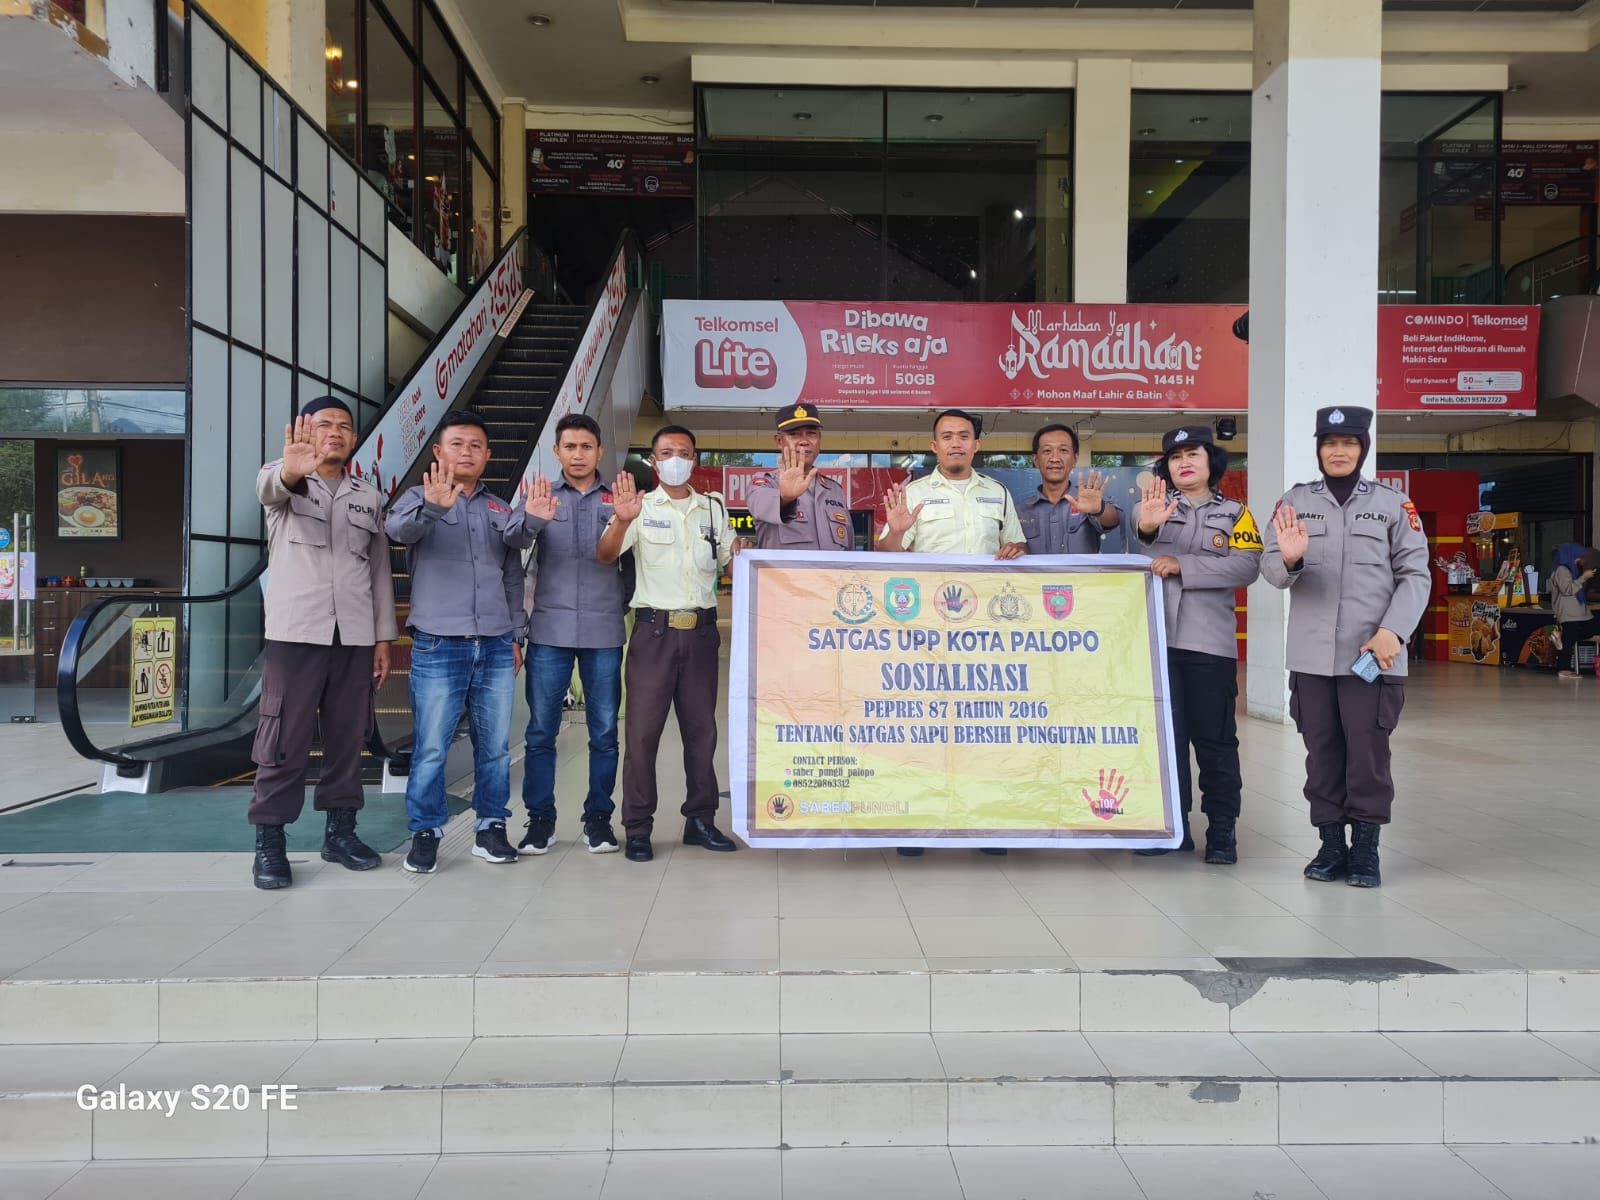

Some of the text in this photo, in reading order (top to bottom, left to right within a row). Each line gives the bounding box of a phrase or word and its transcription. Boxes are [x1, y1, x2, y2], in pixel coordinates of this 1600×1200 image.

[694, 316, 779, 333] Telkomsel
[844, 308, 929, 332] Dibawa
[1025, 309, 1128, 336] Marhaban Ya
[1405, 315, 1464, 325] COMINDO
[1471, 314, 1528, 326] Telkomsel
[819, 328, 948, 362] Rileks aja
[1444, 335, 1487, 343] IndiHome,
[1000, 310, 1201, 384] Ramadhan
[1402, 345, 1526, 353] Internet dan Hiburan di Rumah
[696, 338, 776, 385] Lite
[834, 372, 876, 386] Rp25rb
[895, 372, 936, 386] 50GB
[1154, 374, 1195, 385] 1445 H
[1037, 389, 1163, 400] Mohon Maaf Lahir & Batin
[1354, 512, 1388, 523] POLRI
[808, 628, 1099, 653] SATGAS UPP KOTA PALOPO
[881, 662, 1029, 692] SOSIALISASI
[864, 700, 1049, 719] PEPRES 87 TAHUN 2016
[775, 725, 1140, 745] TENTANG SATGAS SAPU BERSIH PUNGUTAN LIAR
[793, 756, 858, 766] CONTACT PERSON:
[1094, 807, 1124, 815] PUNGLI
